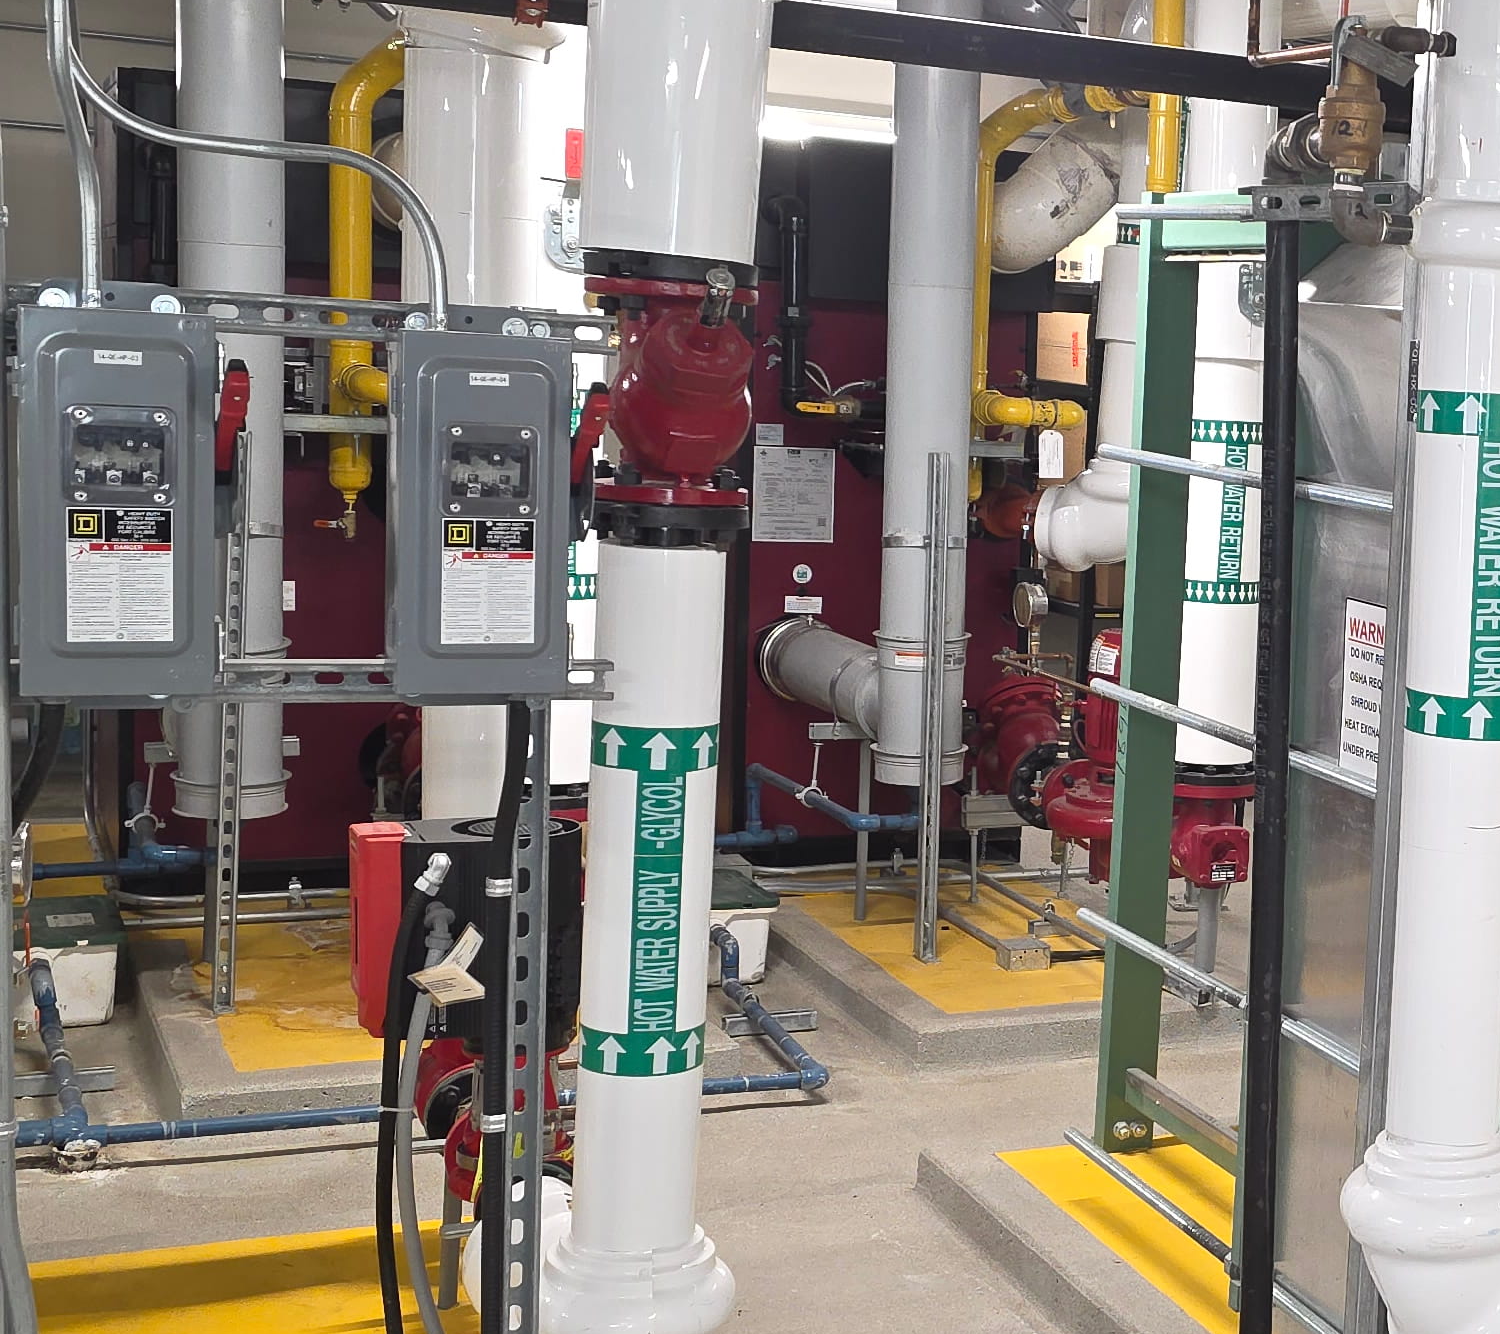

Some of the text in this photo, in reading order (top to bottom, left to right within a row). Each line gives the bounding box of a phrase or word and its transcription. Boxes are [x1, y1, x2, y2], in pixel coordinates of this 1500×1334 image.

[1219, 526, 1241, 580] RETURN
[1349, 617, 1384, 645] WARN
[1350, 647, 1360, 660] DO
[1360, 649, 1375, 663] NOT
[1349, 671, 1368, 686] OSHA
[1350, 695, 1378, 713] SHROUD
[1344, 718, 1380, 739] HEAT EXCHA
[1343, 741, 1366, 759] UNDER
[637, 870, 680, 931] SUPPLY
[635, 937, 677, 996] WATER
[633, 999, 674, 1033] HOT
